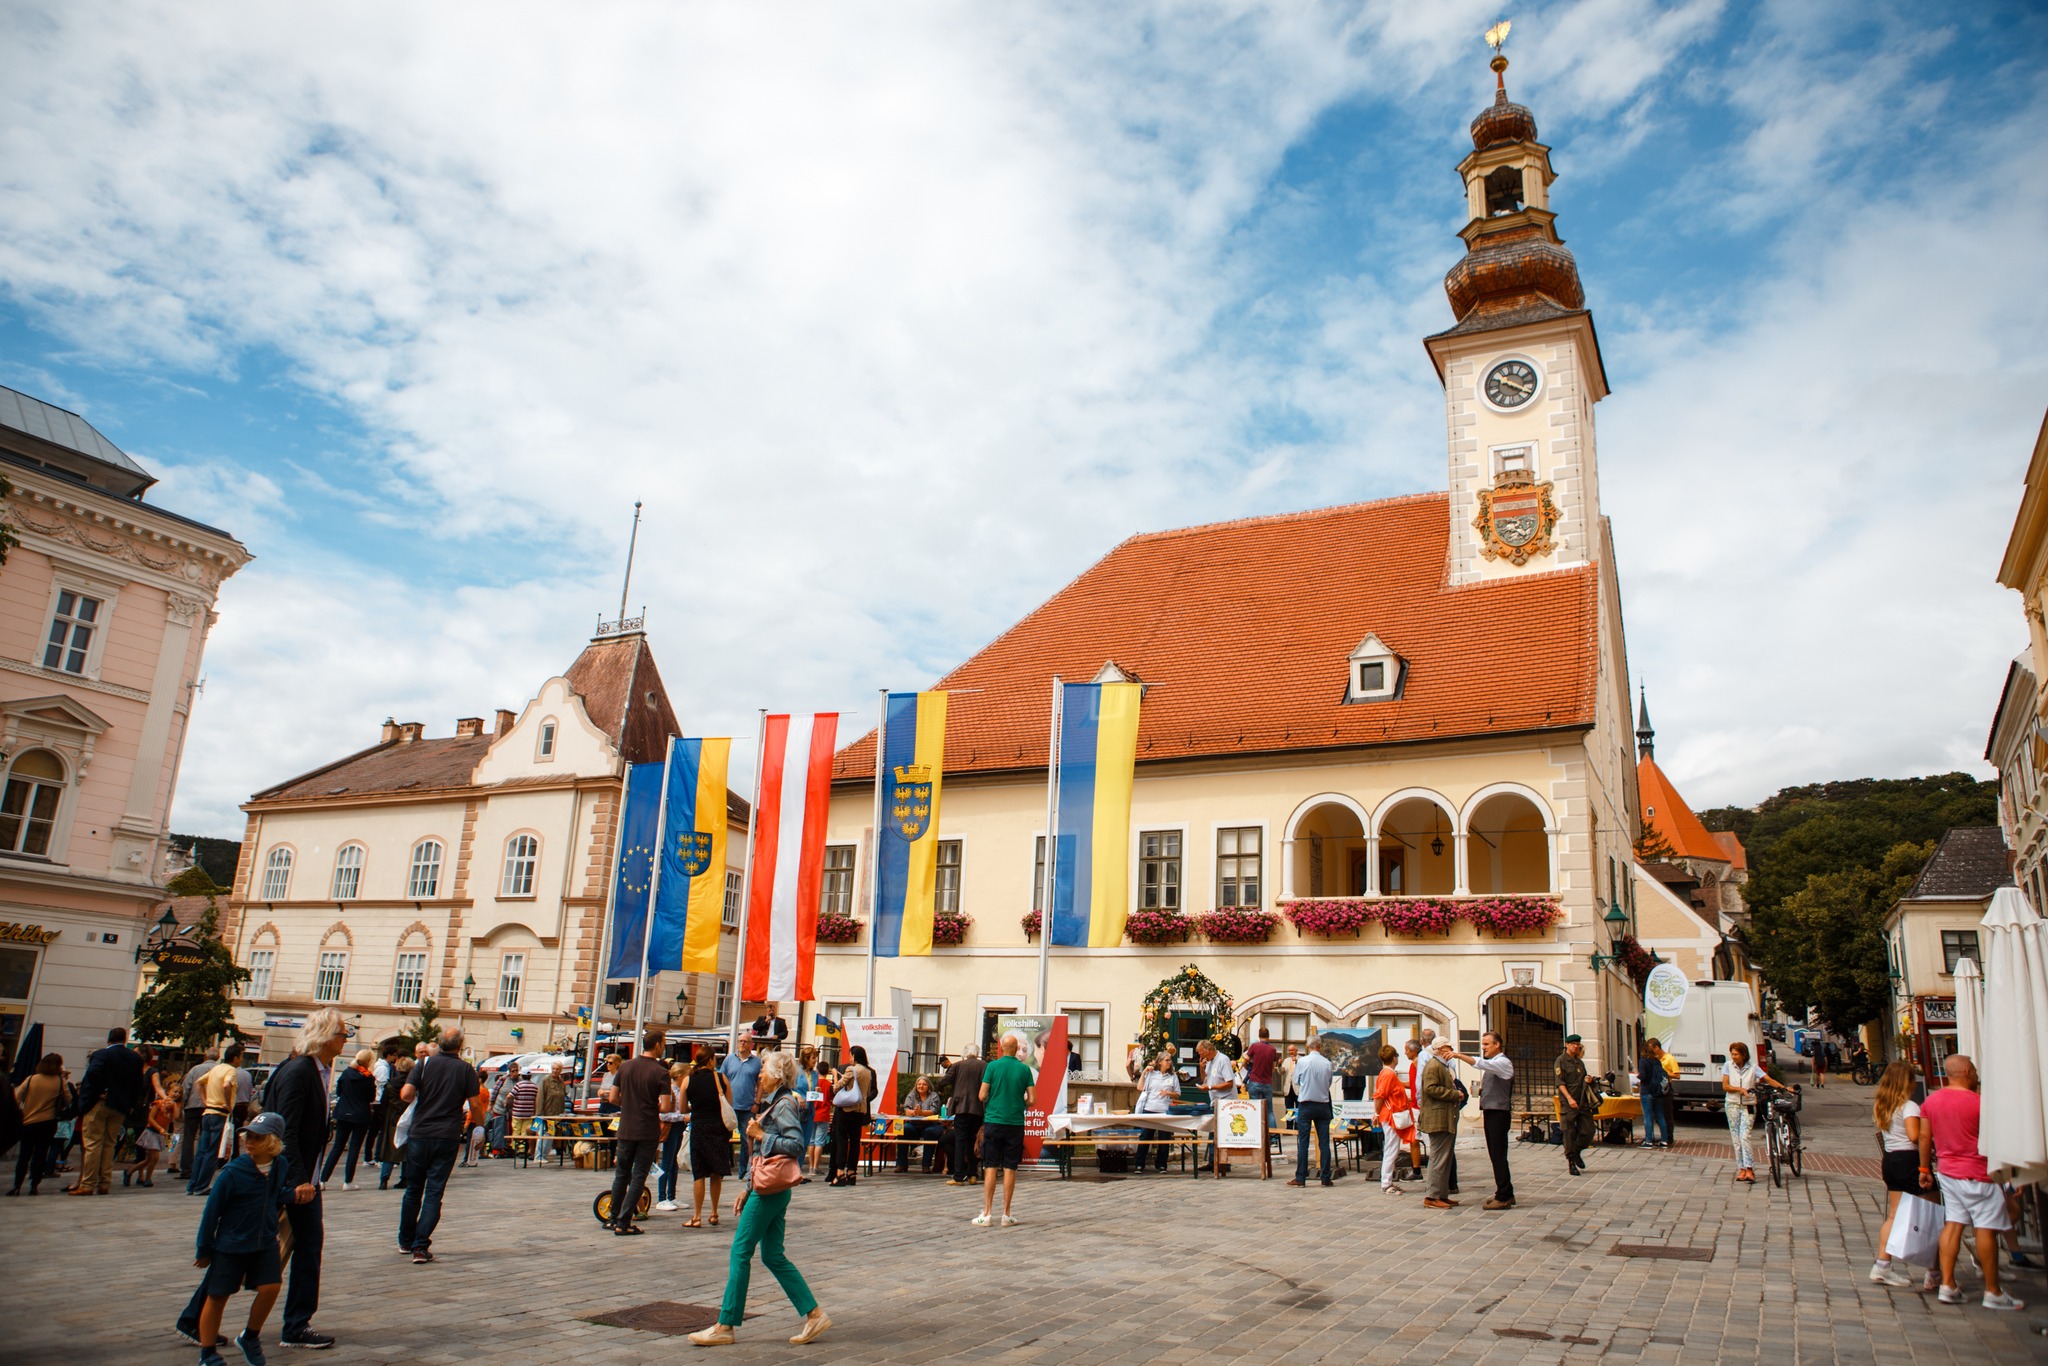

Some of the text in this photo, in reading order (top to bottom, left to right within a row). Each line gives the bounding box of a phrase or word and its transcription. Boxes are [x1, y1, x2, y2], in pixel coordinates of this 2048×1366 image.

[172, 955, 203, 964] Tchibo
[1925, 1002, 1956, 1011] WELT
[1926, 1010, 1956, 1019] LADEN
[861, 1023, 894, 1031] volkshilfe.
[1002, 1019, 1041, 1028] volkshilfe.
[1023, 1109, 1045, 1118] tarke
[1033, 1118, 1045, 1127] für
